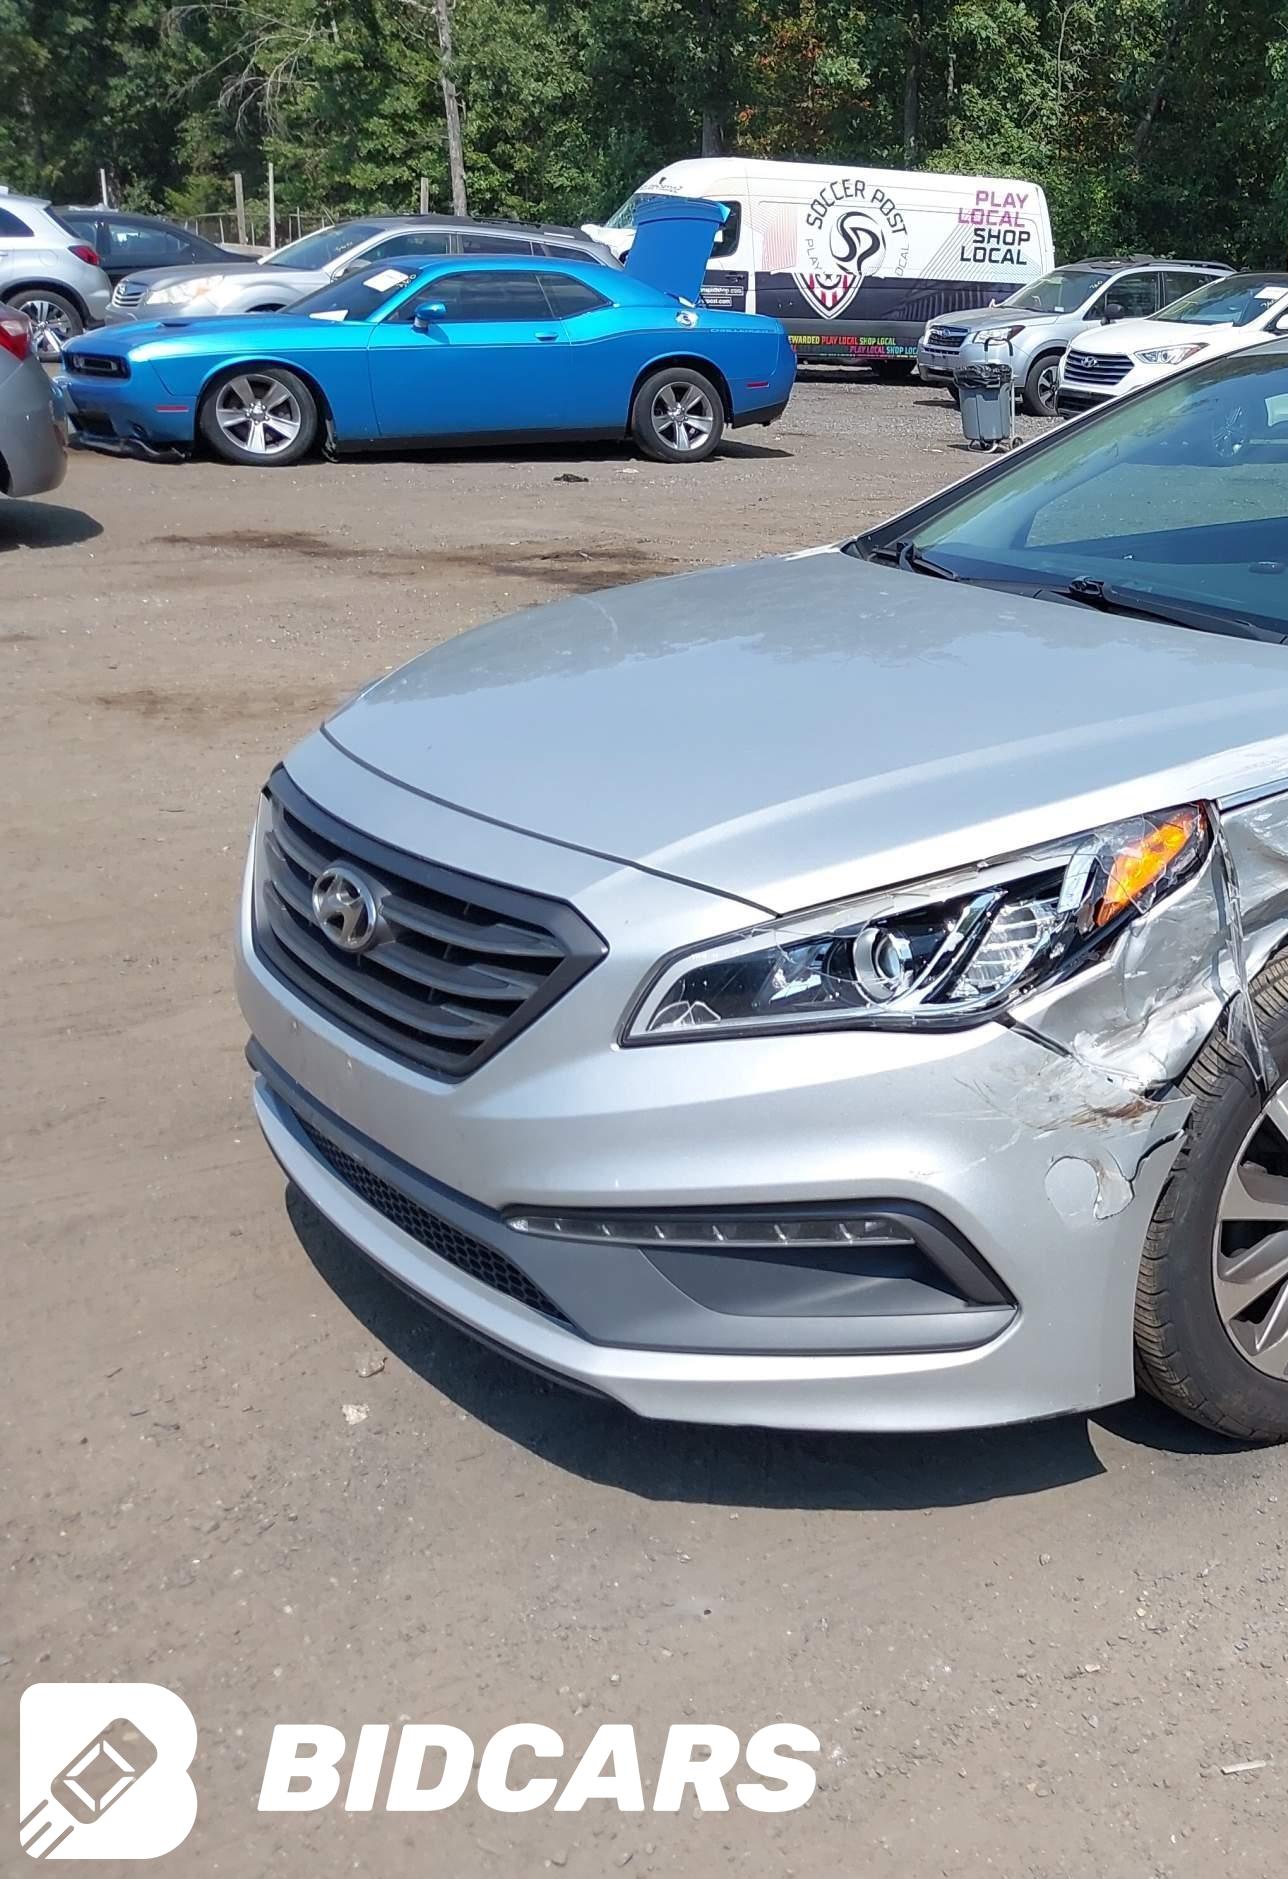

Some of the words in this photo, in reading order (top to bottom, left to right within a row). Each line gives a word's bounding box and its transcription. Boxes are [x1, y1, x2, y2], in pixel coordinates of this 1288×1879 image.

[806, 179, 866, 230] SOCCER
[870, 188, 908, 235] POST
[975, 190, 1029, 209] PLAY
[958, 207, 1026, 228] LOCAL
[973, 227, 1031, 246] SHOP
[805, 238, 823, 271] PLAY
[894, 242, 910, 277] OCAL
[960, 246, 1027, 266] LOCAL
[821, 336, 838, 345] PLAY
[838, 336, 858, 345] LOCAL
[859, 337, 876, 346] SHOP
[876, 337, 897, 346] LOCAL
[849, 346, 866, 354] PLAY
[866, 346, 886, 354] LOCAL
[886, 346, 904, 355] SHOP
